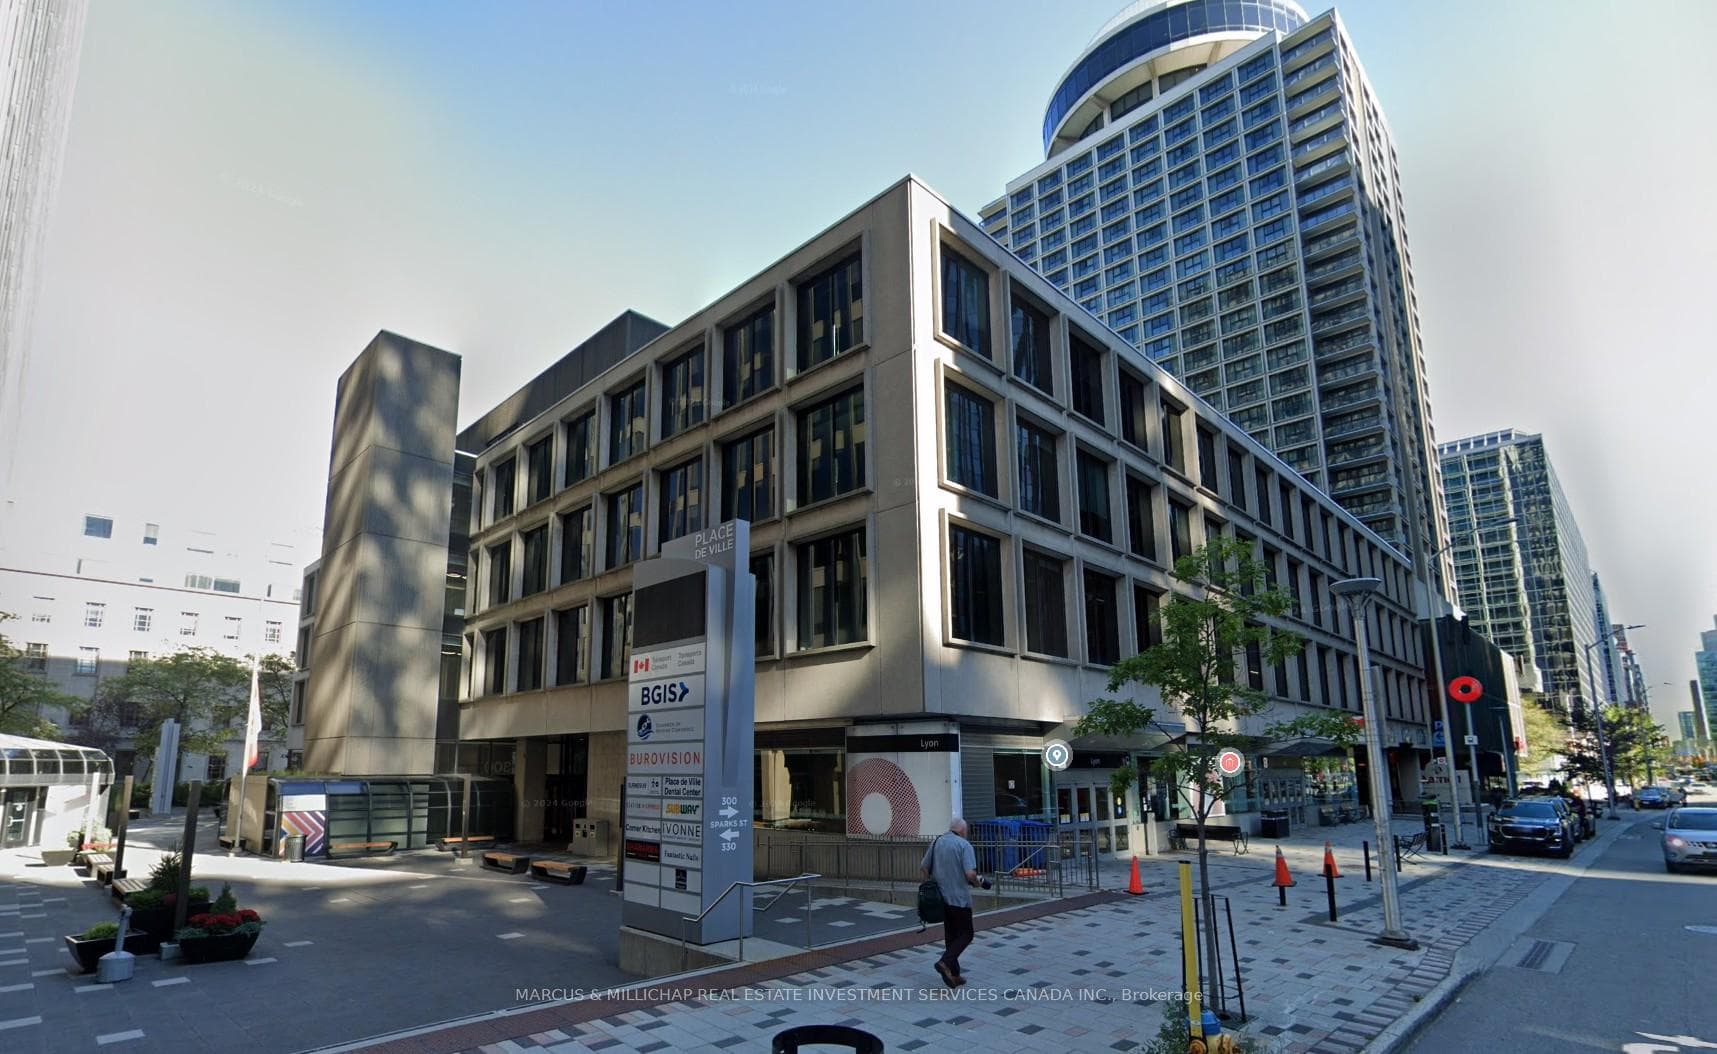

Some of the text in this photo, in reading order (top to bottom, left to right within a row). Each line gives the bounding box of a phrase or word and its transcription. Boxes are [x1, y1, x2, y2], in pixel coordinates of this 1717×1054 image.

[695, 522, 734, 547] PLACE
[695, 538, 734, 560] DE VILLE
[641, 683, 677, 706] BGIS
[920, 738, 939, 750] Lyon
[630, 751, 701, 765] BUROVISION
[665, 777, 680, 786] Place
[688, 777, 701, 786] Ville
[664, 787, 681, 796] Dental
[682, 787, 701, 796] Center
[721, 796, 737, 806] 300
[665, 803, 699, 815] SUBWAY
[662, 823, 701, 837] IVONNE
[710, 819, 748, 829] SPARKS ST
[721, 842, 737, 852] 330
